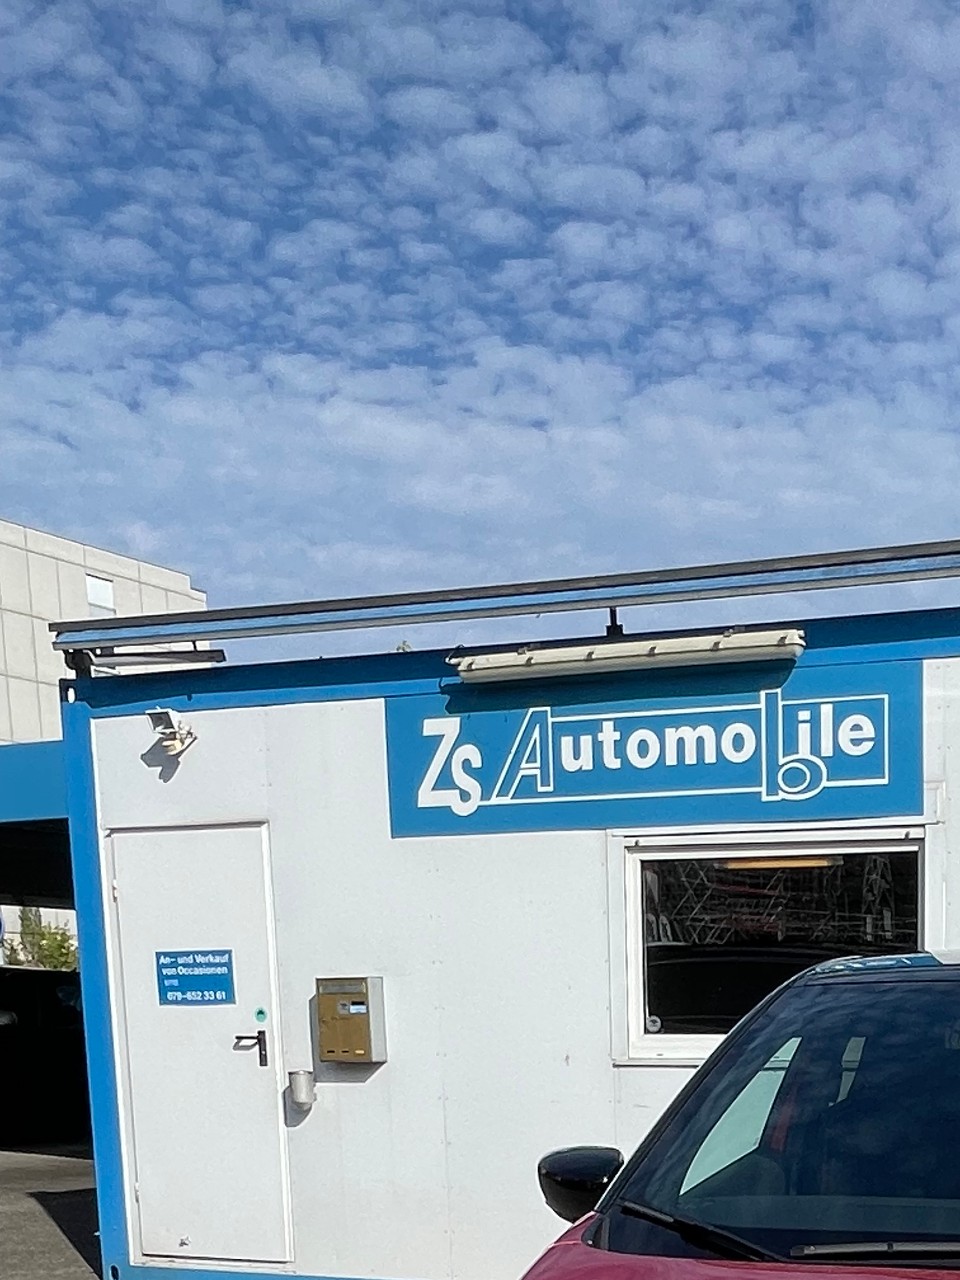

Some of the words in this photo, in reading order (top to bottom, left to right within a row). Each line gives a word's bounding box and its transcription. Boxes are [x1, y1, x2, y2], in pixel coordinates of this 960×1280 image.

[489, 688, 877, 802] Automobile
[177, 954, 194, 963] und
[194, 953, 229, 963] Verkauf
[161, 967, 177, 975] von
[177, 965, 228, 975] Occasionen
[203, 990, 215, 1000] 33
[215, 990, 226, 1000] 61
